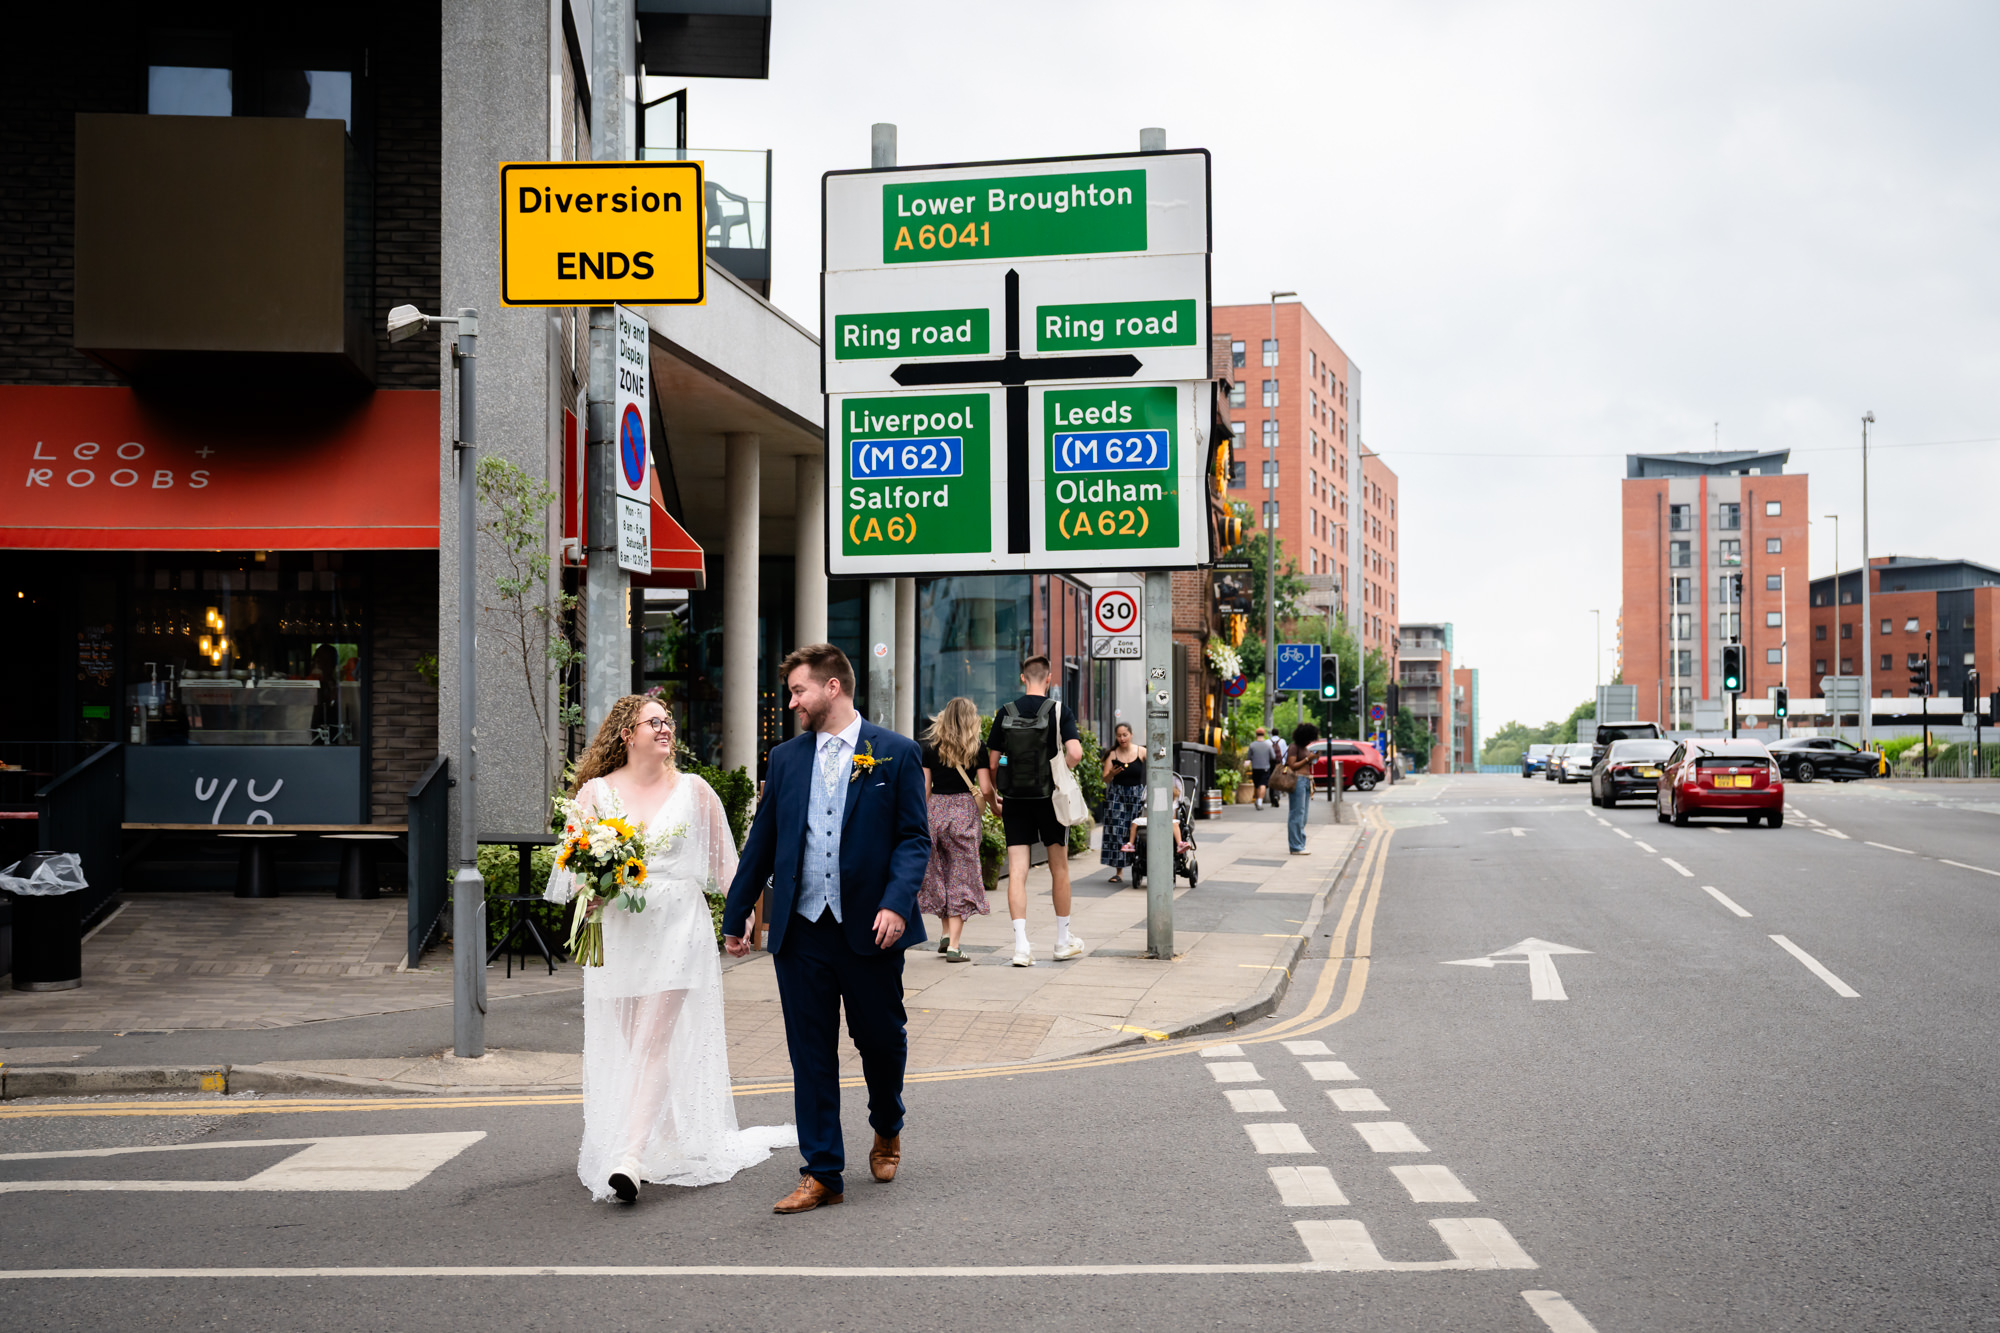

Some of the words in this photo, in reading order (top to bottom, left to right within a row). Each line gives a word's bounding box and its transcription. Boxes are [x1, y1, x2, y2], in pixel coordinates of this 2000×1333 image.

[519, 185, 682, 213] Diversion
[897, 194, 976, 217] Lower
[988, 183, 1132, 213] Broughton
[557, 251, 655, 280] ENDS
[620, 313, 631, 339] Pay
[633, 326, 645, 343] and
[843, 325, 901, 350] Ring
[911, 319, 972, 344] road
[1045, 315, 1104, 341] Ring
[1115, 310, 1178, 336] road
[620, 339, 645, 370] Display
[620, 367, 645, 399] ZONE
[850, 406, 974, 435] Liverpool
[1054, 401, 1132, 426] Leeds
[849, 484, 949, 510] Salford
[1056, 479, 1163, 504] Oldham
[1101, 602, 1131, 619] 30
[1113, 647, 1138, 655] ENDS
